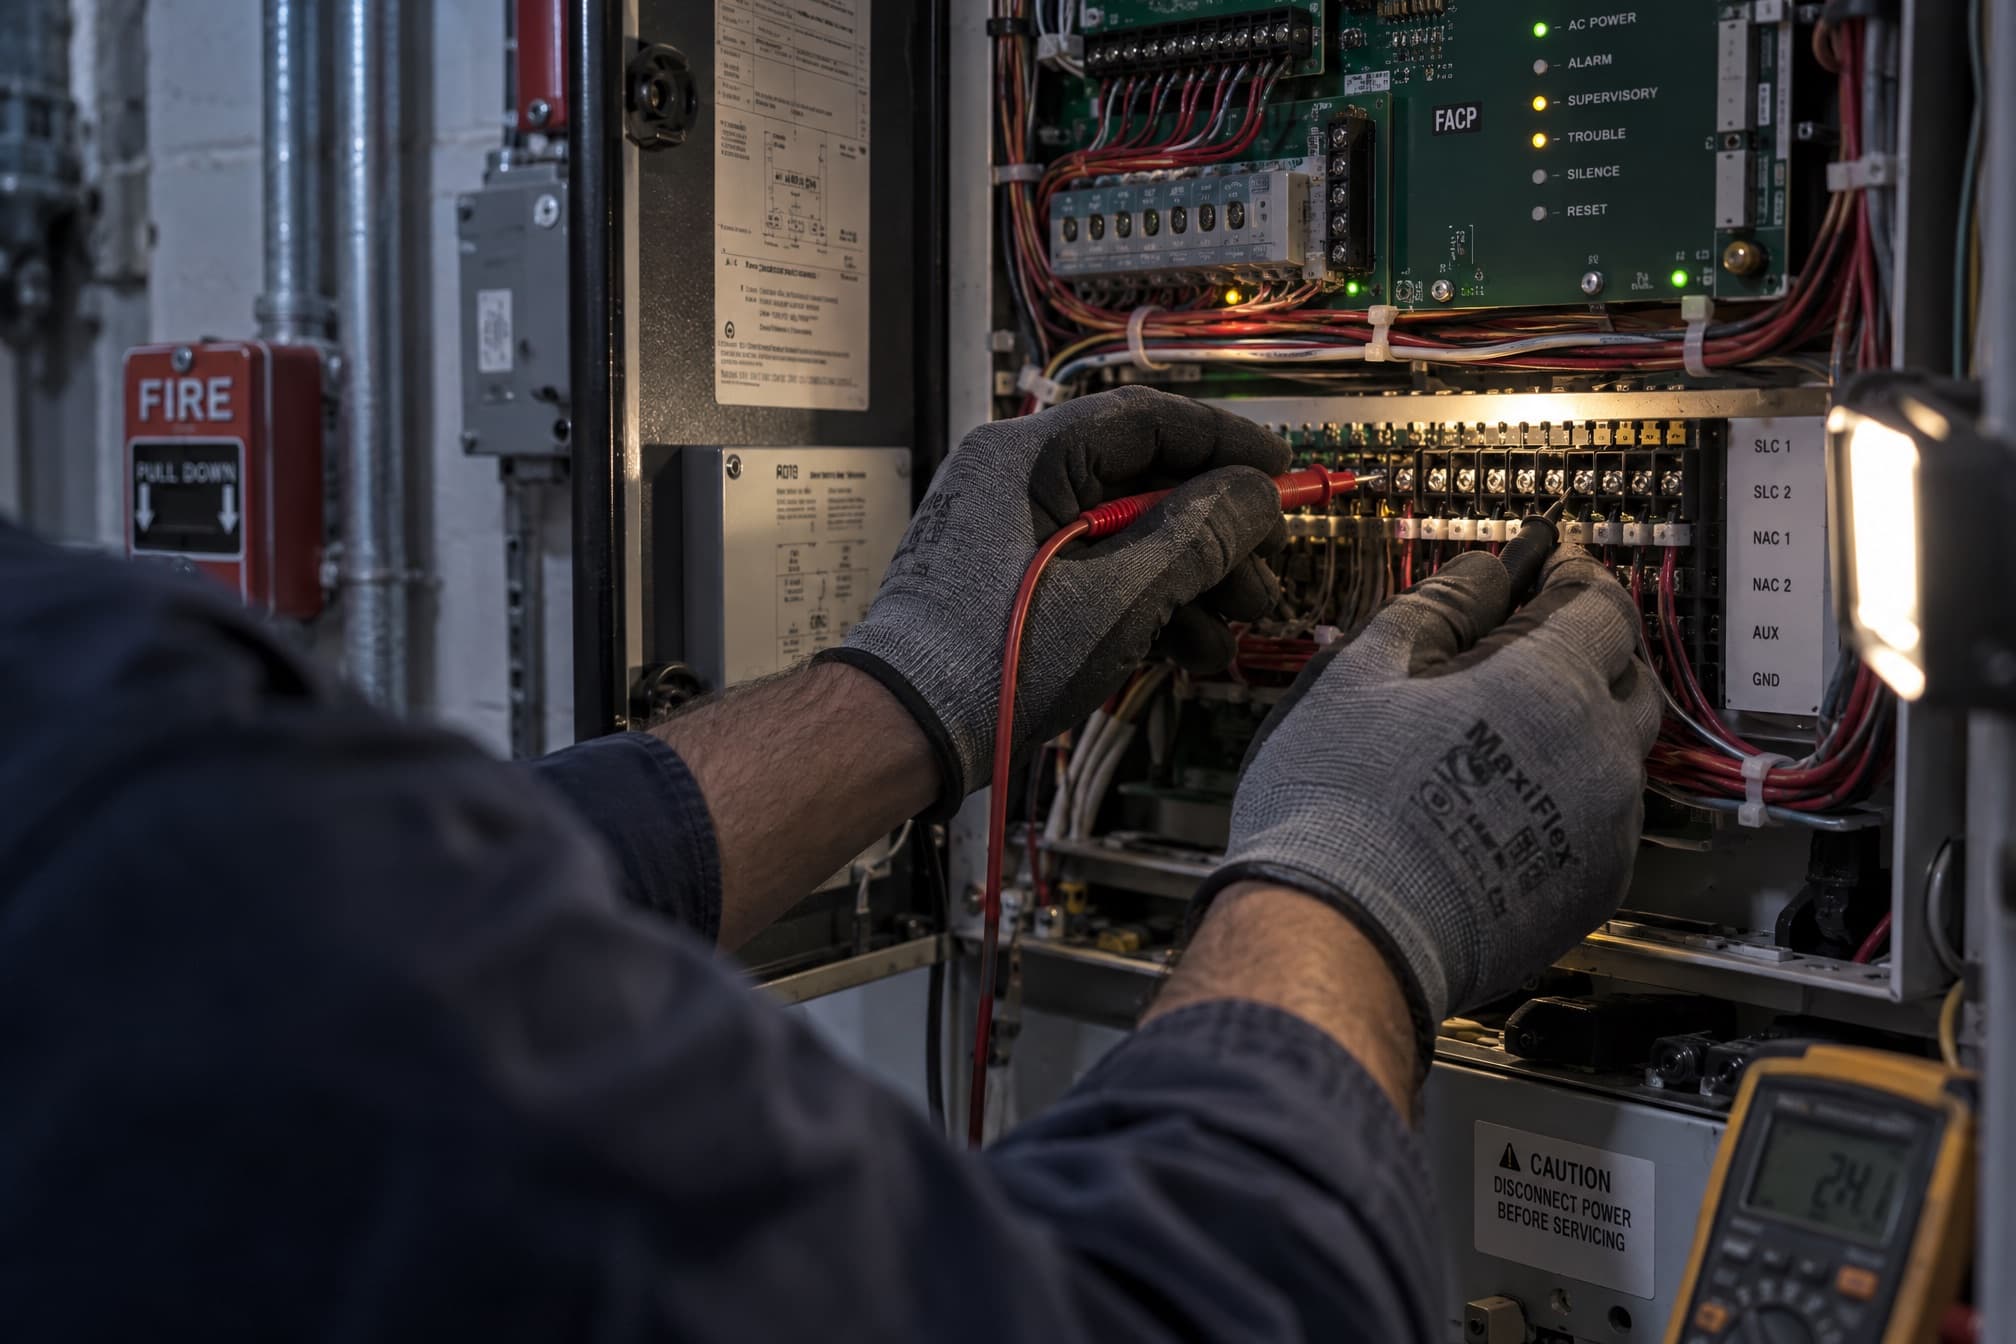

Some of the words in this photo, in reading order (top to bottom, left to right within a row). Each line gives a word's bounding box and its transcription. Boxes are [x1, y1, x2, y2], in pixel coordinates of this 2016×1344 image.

[1568, 19, 1587, 32] AC
[1590, 12, 1637, 29] POWER
[1568, 54, 1613, 70] ALARM
[1568, 87, 1659, 107] SUPERVISORY
[1435, 107, 1478, 133] FACP
[1568, 128, 1626, 144] TROUBLE
[1567, 165, 1620, 180] SILENCE
[1567, 204, 1608, 217] RESET
[138, 376, 233, 422] FIRE
[1755, 439, 1780, 454] SLC
[1785, 440, 1791, 453] 1
[137, 462, 178, 483] PULL
[183, 461, 237, 483] DOWN
[1754, 485, 1779, 499] SLC
[1784, 486, 1792, 499] 2
[1753, 531, 1780, 545] NAC
[1785, 532, 1791, 545] 1
[1753, 578, 1780, 592] NAC
[1784, 579, 1792, 592] 2
[1752, 625, 1780, 640] AUX
[1752, 672, 1780, 687] GND
[1465, 718, 1575, 869] MaxiFlex
[1530, 1153, 1611, 1193] CAUTION
[1494, 1175, 1577, 1214] DISCONNECT
[1582, 1198, 1632, 1229] POWER
[1497, 1201, 1549, 1231] BEFORE
[1553, 1215, 1625, 1252] SERVICING
